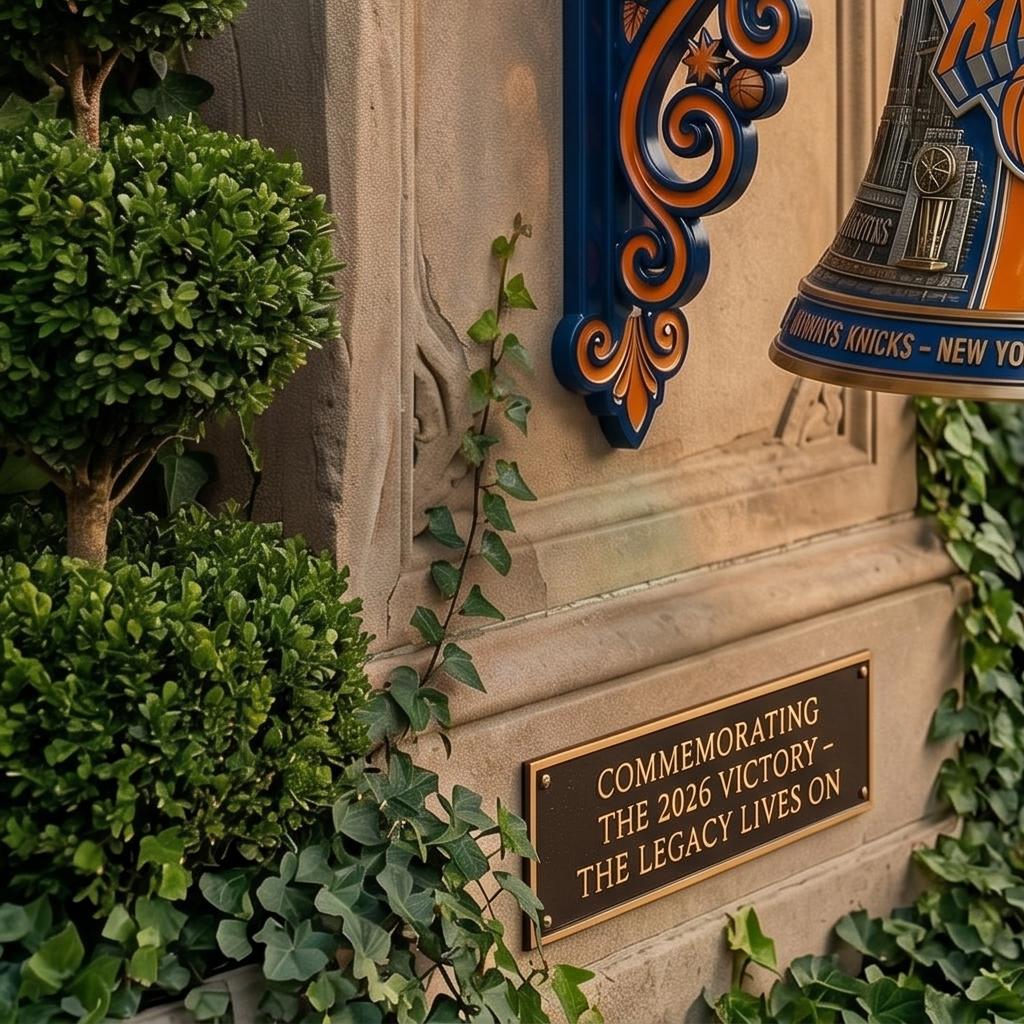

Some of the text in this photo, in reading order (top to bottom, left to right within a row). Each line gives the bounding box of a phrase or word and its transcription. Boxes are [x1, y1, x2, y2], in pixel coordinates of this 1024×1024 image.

[844, 325, 916, 359] KNICKS
[937, 337, 988, 365] NEW
[598, 697, 820, 799] COMMEMORATING
[598, 801, 649, 844] THE
[657, 777, 711, 823] 2026
[718, 737, 818, 798] VICTORY
[577, 769, 841, 898] THE LEGACY LIVES ON
